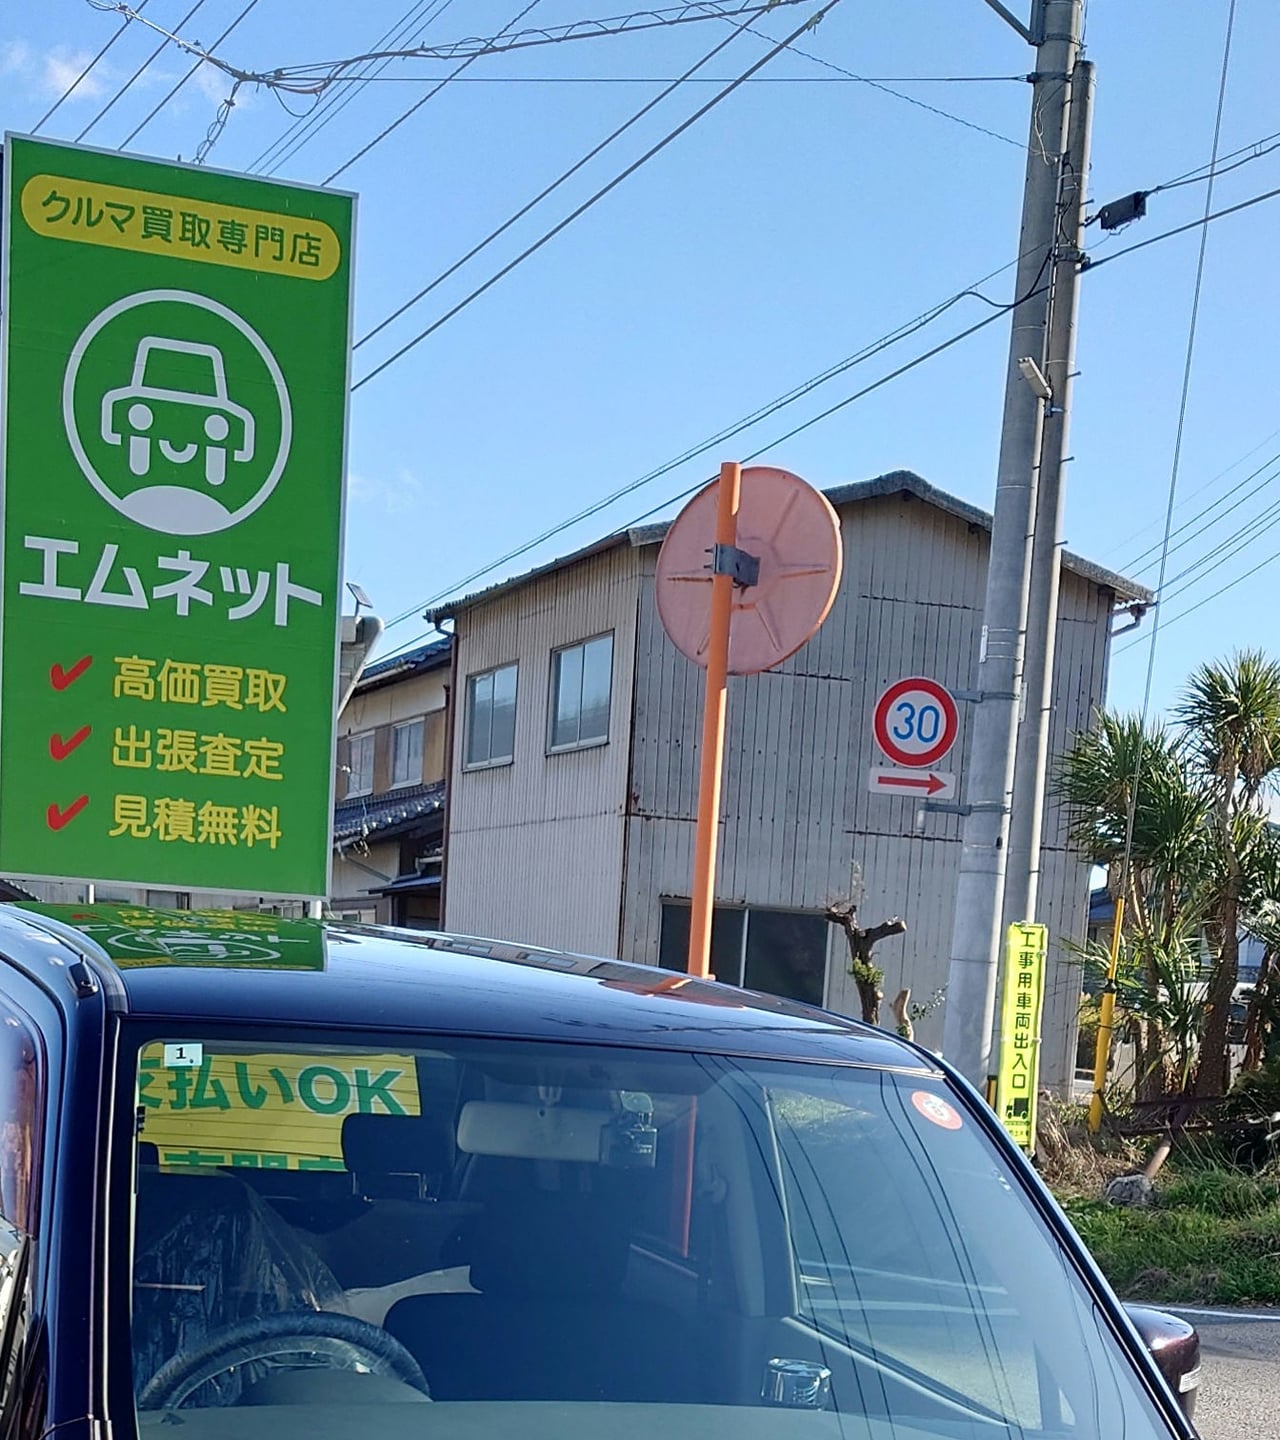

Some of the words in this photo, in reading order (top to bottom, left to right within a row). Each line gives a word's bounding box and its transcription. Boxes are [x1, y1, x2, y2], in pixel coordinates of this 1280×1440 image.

[41, 189, 322, 268] クルマ買取専門店
[20, 535, 322, 627] エムネット
[113, 655, 287, 713] 高価買取
[892, 701, 941, 744] 30
[111, 724, 284, 781] 出張査定
[108, 794, 282, 849] 見積無料
[1012, 931, 1035, 1089] 工事用車両出入口
